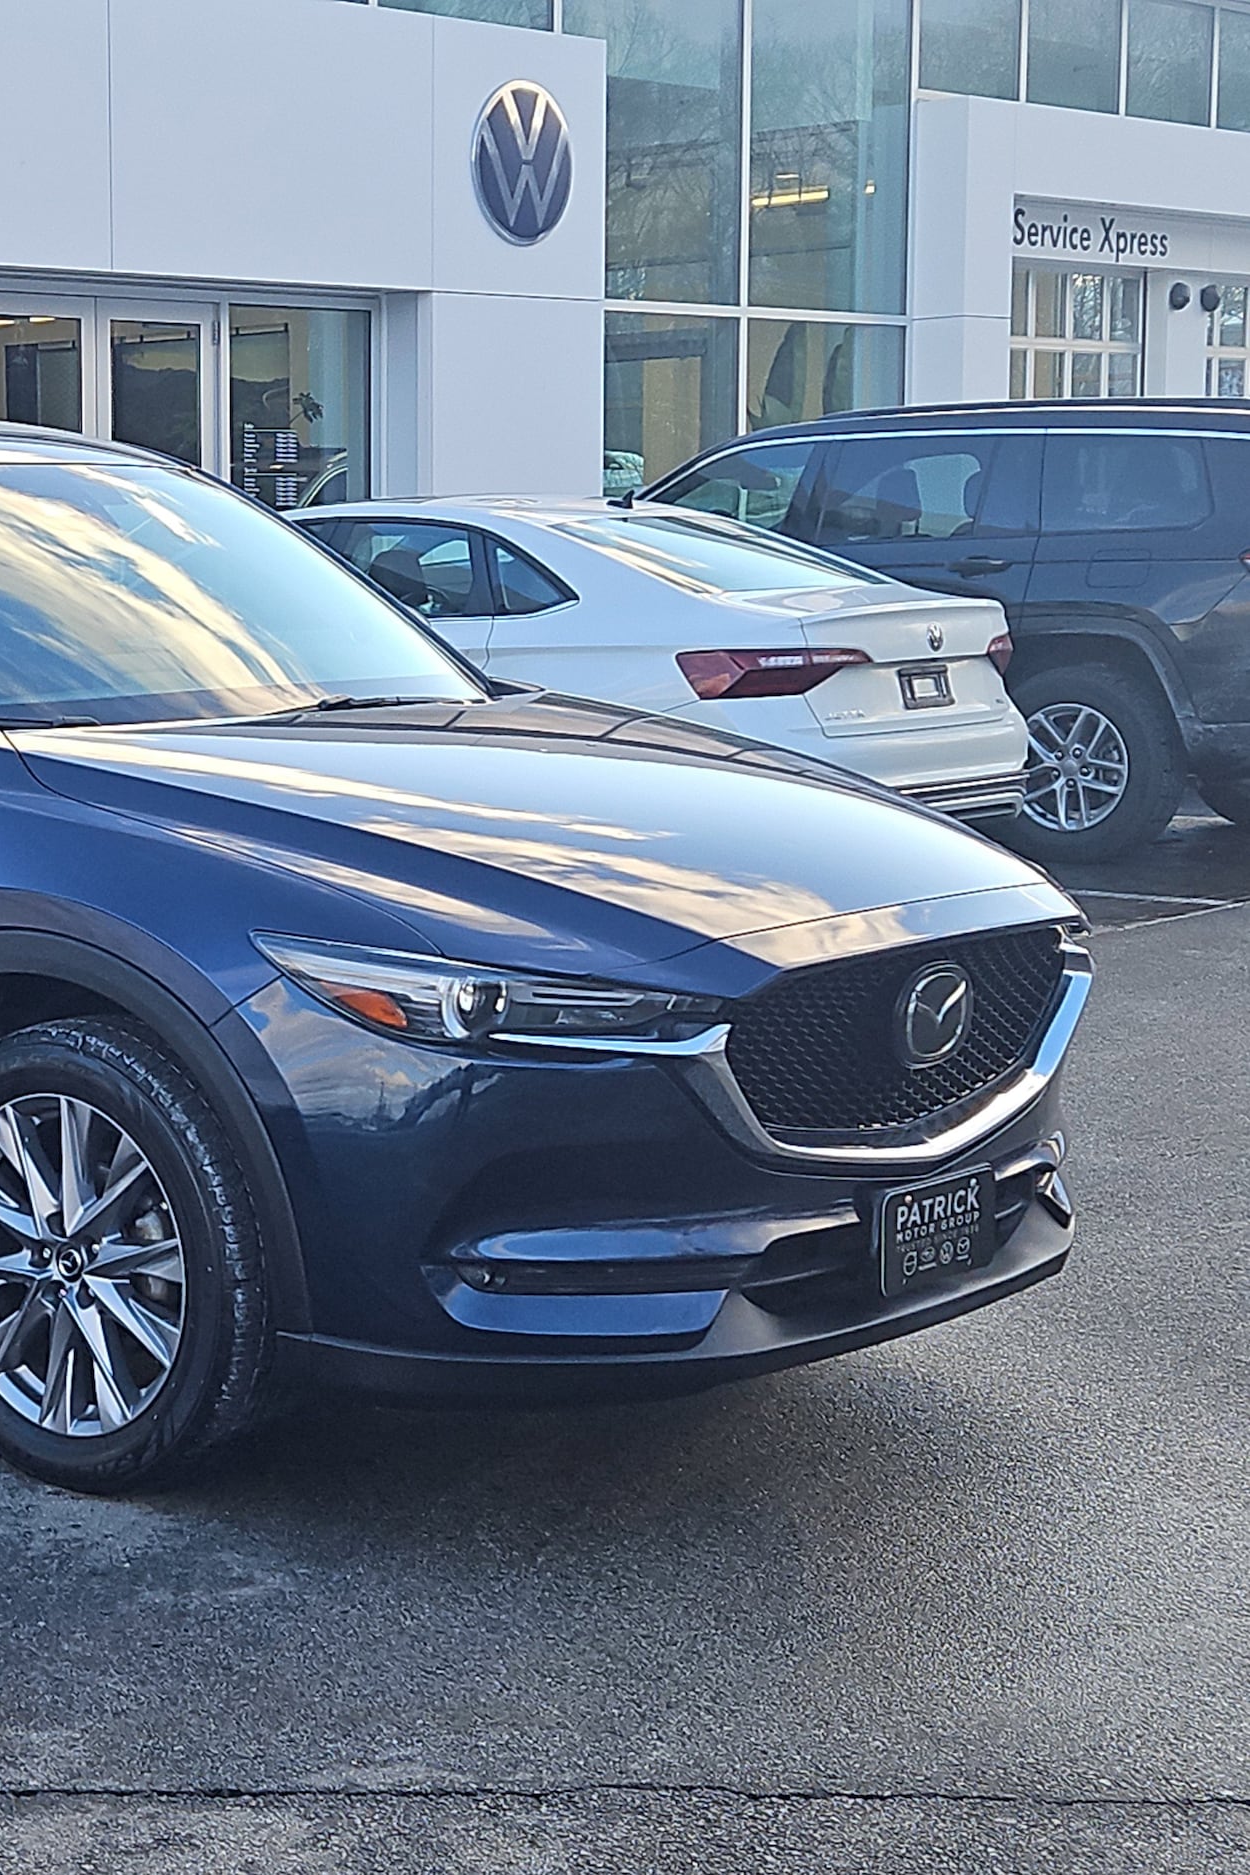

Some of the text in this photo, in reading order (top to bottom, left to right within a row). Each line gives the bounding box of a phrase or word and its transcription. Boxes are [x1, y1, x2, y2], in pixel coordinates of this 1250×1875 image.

[1012, 207, 1169, 263] Service Xpress
[896, 1222, 936, 1244] MOTOR
[940, 1210, 980, 1231] GROUP
[897, 1187, 980, 1231] PATRICK
